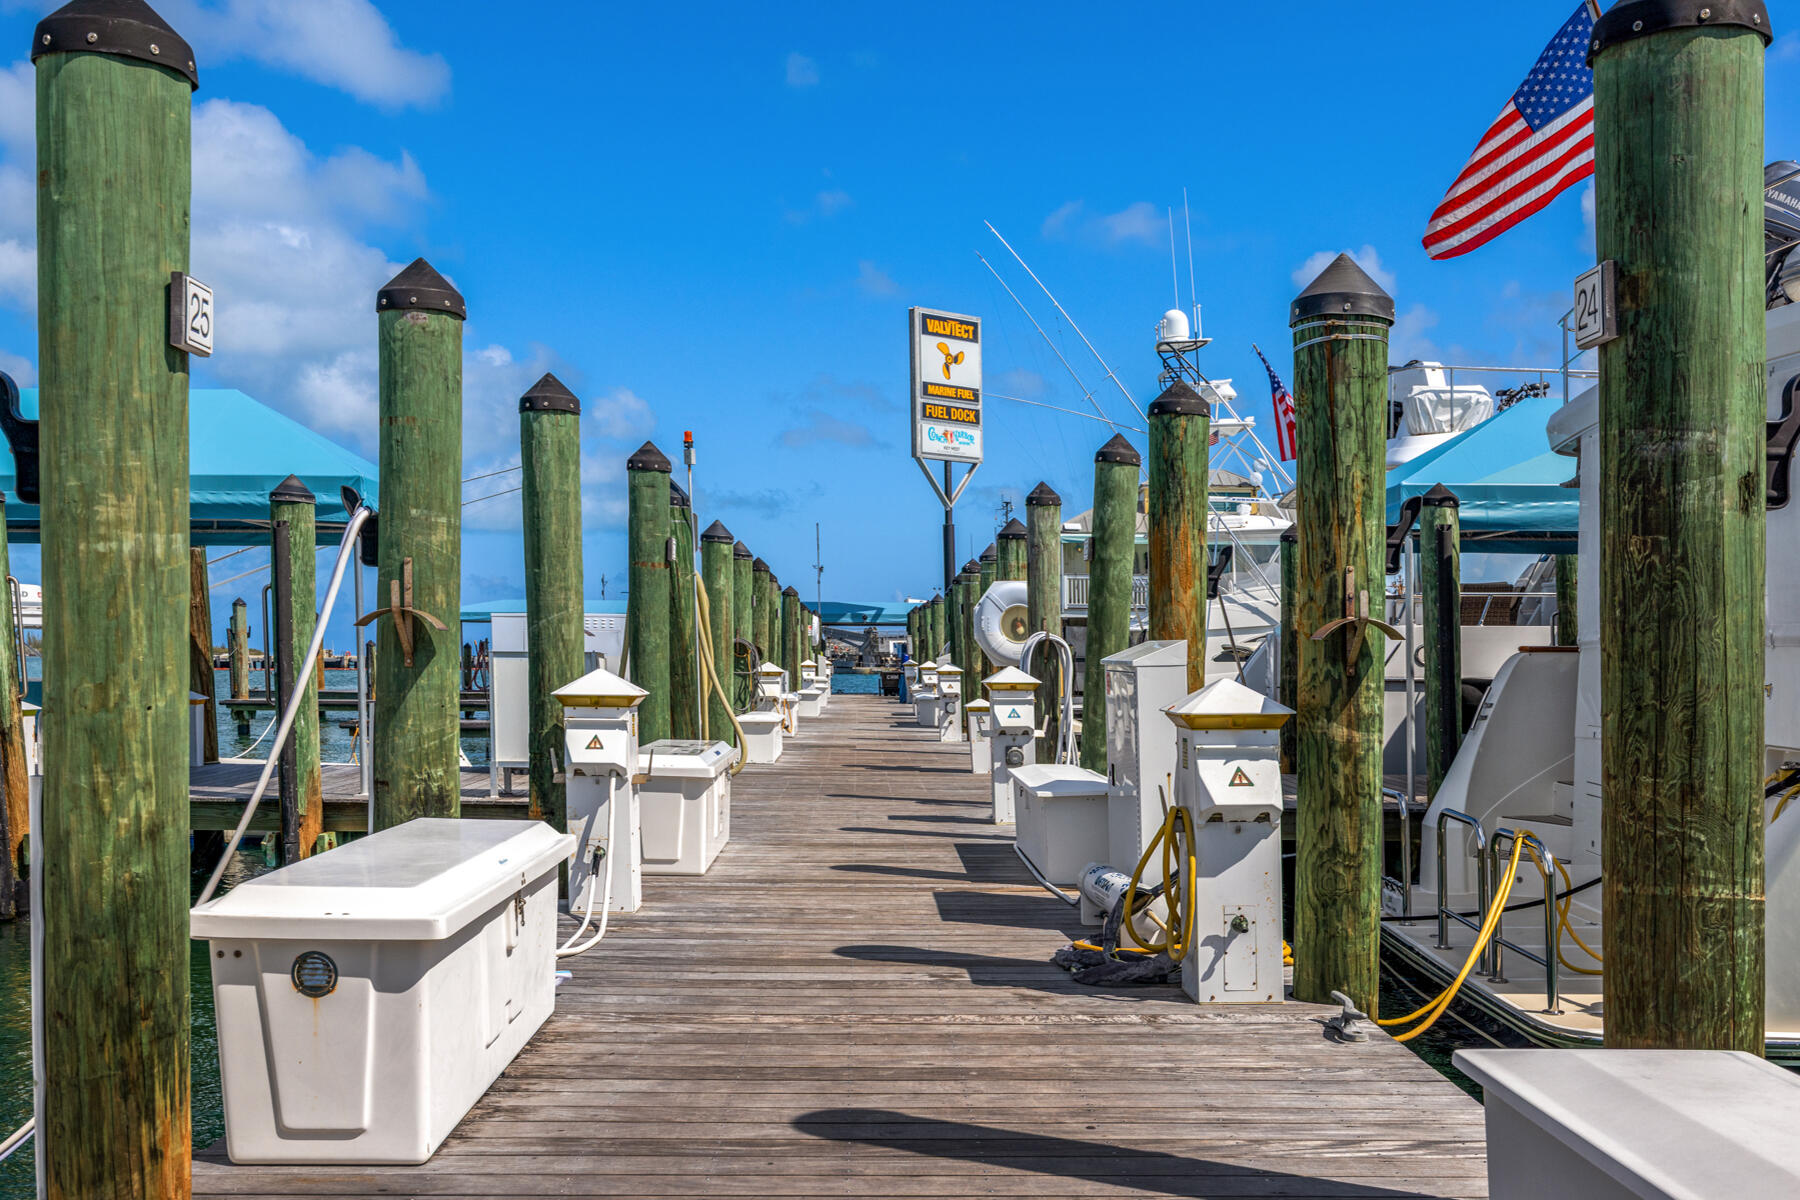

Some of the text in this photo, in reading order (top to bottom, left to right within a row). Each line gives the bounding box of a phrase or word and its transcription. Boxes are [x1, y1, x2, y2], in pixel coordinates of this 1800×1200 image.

[1767, 188, 1800, 211] YAMAHA
[190, 293, 210, 338] 25
[1577, 284, 1598, 332] 24
[926, 318, 974, 339] VALVTECT
[928, 384, 975, 400] MARINE FUEL
[926, 404, 976, 423] FUEL DOCK
